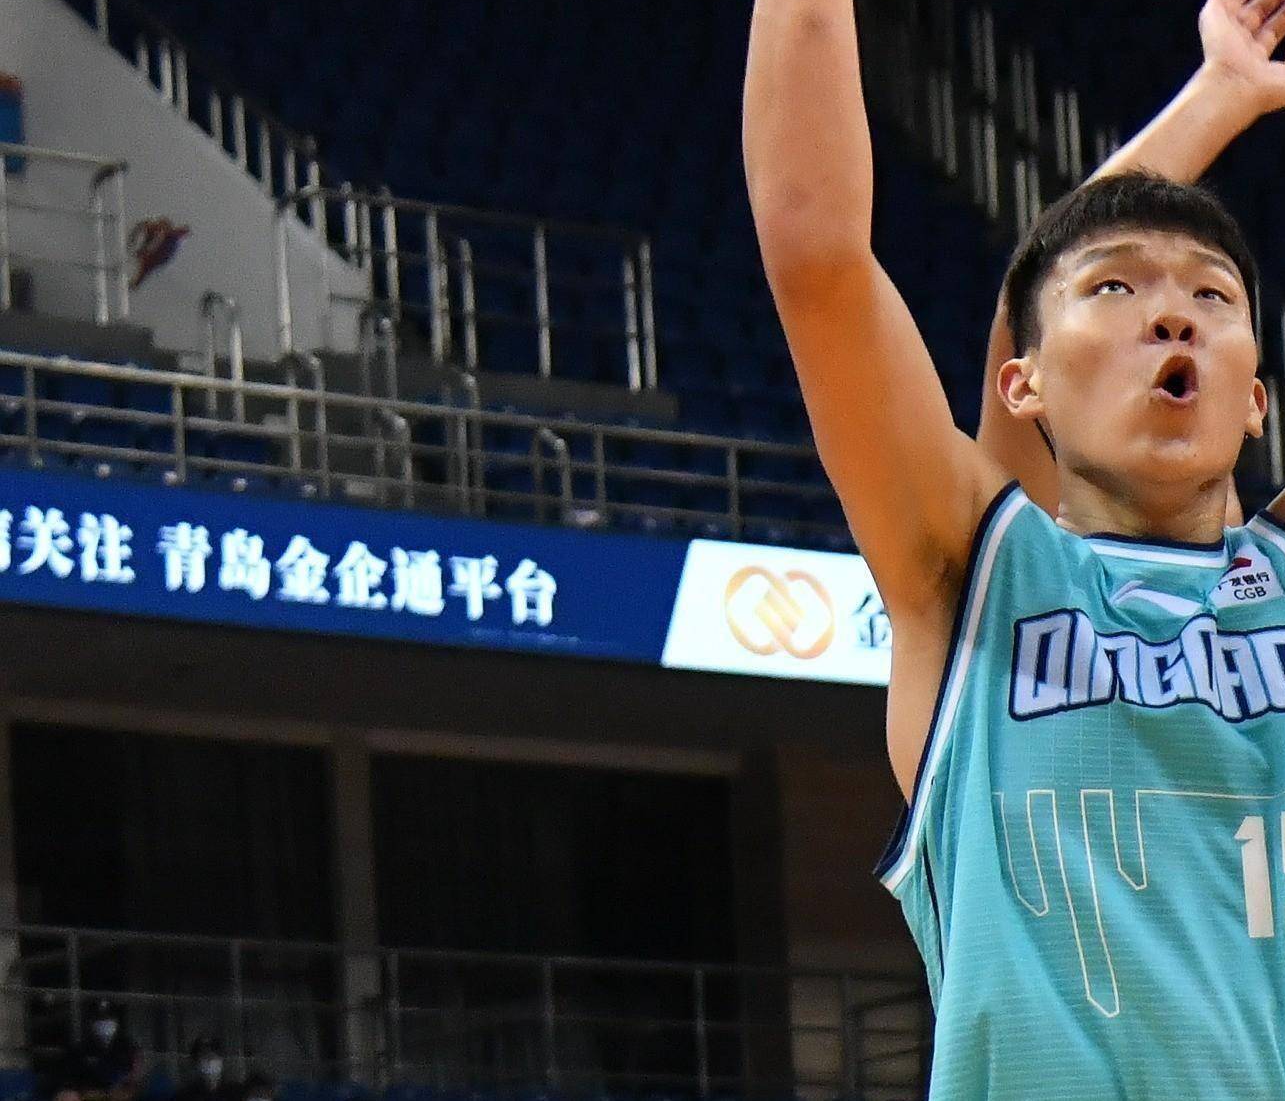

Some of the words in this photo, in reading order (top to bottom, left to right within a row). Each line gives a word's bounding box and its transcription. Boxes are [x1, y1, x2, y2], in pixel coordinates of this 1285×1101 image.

[0, 505, 136, 583] 关注
[158, 521, 559, 628] 青岛金企通平台
[1233, 586, 1267, 601] CGB
